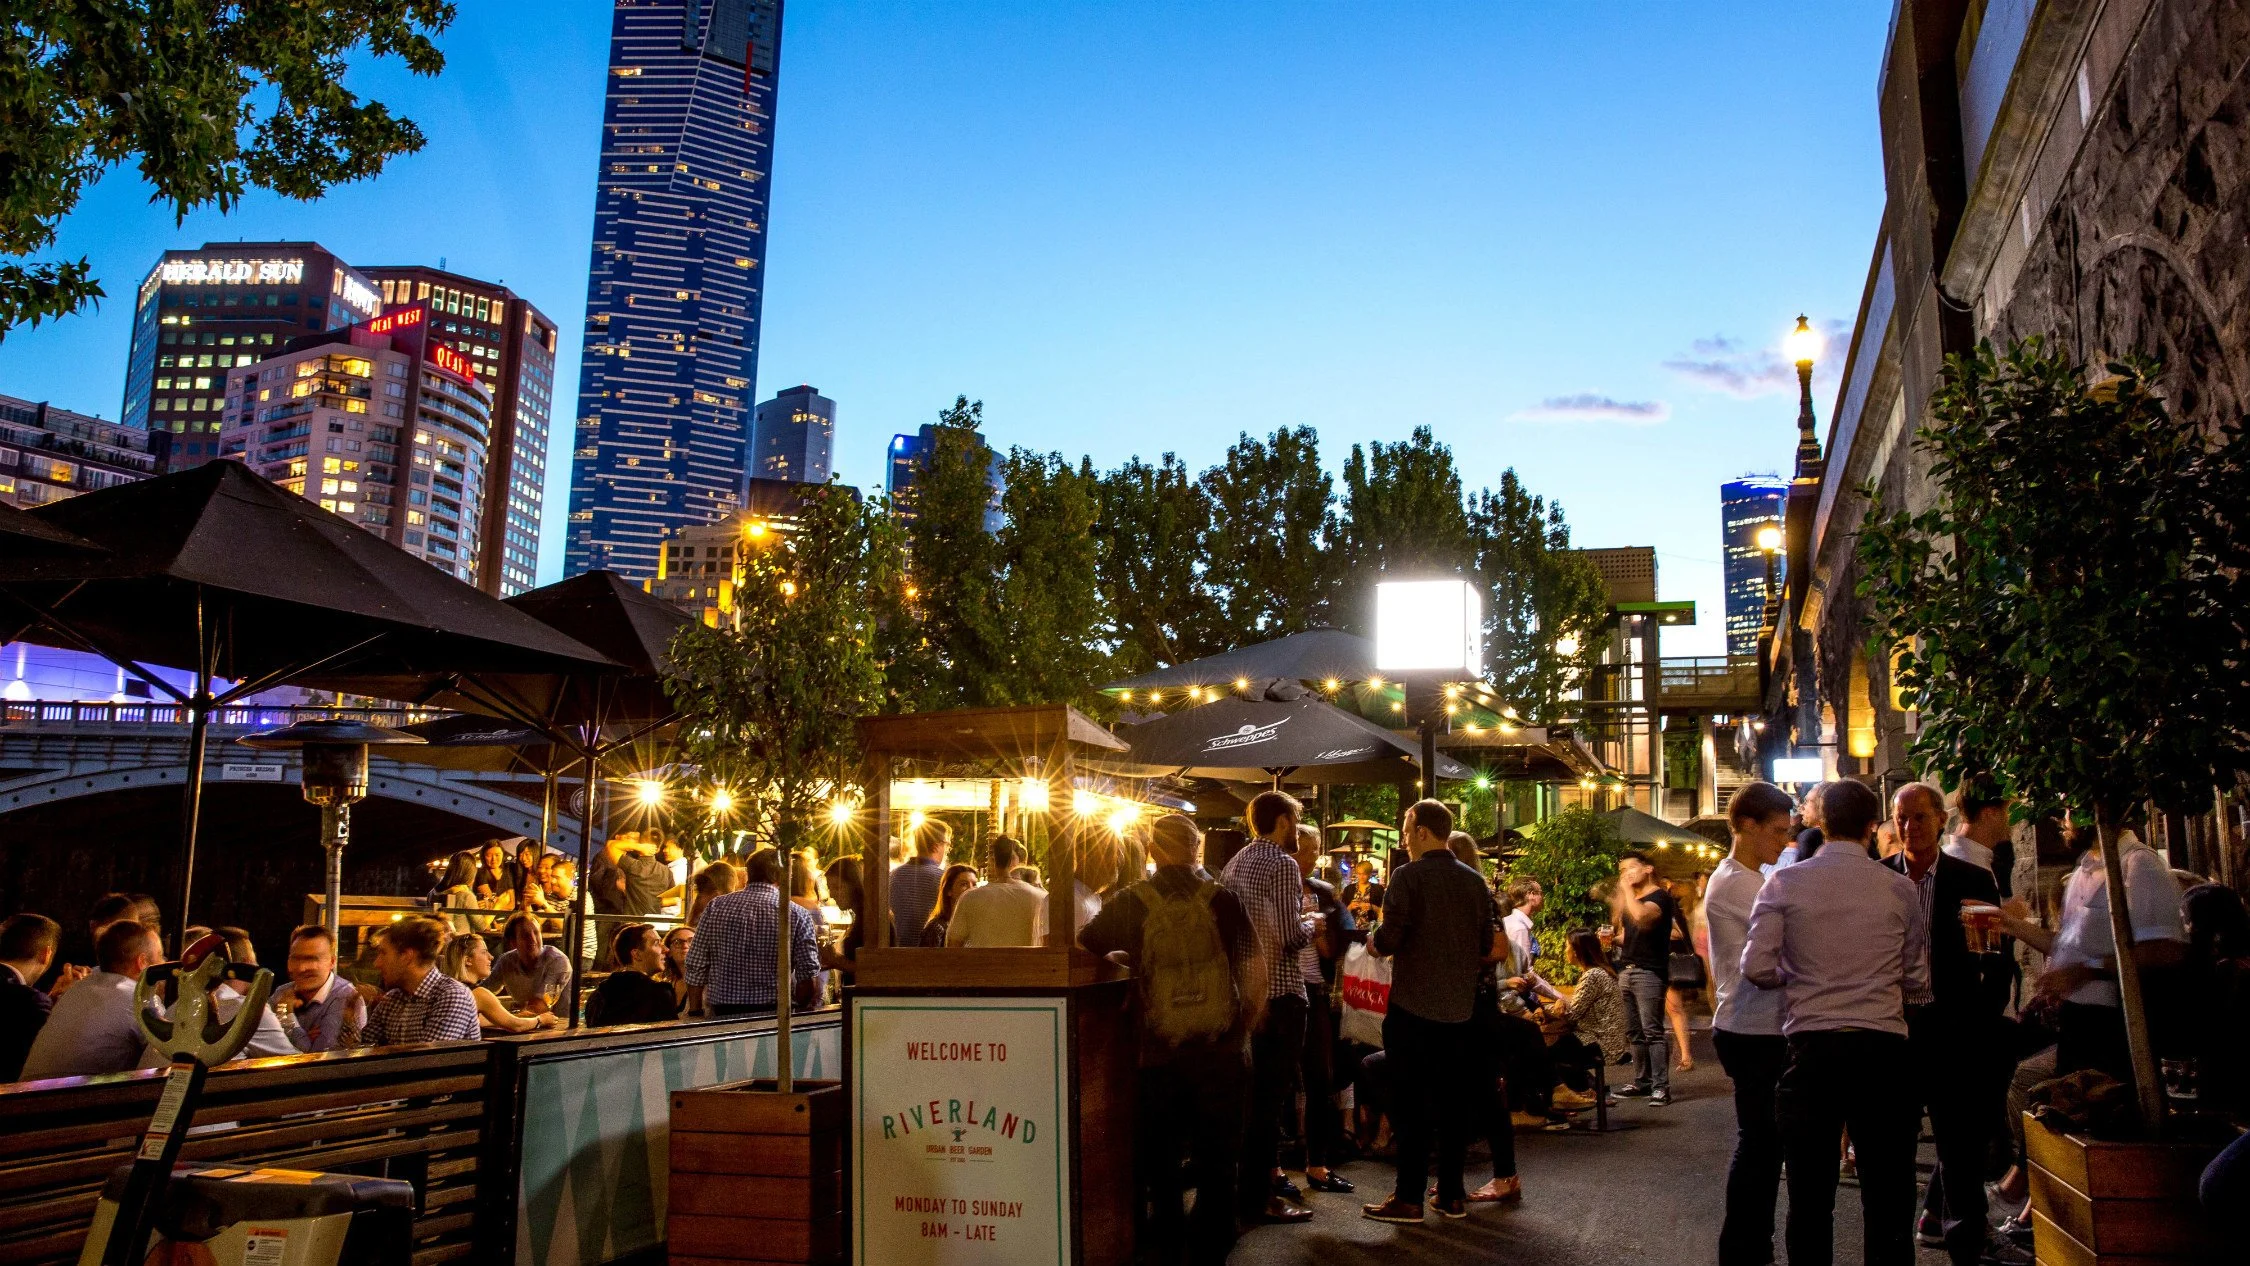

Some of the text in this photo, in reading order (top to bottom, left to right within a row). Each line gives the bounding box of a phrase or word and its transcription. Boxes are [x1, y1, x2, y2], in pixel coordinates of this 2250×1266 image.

[161, 261, 304, 281] HERALD SUN
[397, 309, 421, 325] WEST
[1211, 727, 1278, 748] Schweppes
[907, 1041, 1007, 1062] WELCOME TO
[882, 1098, 1037, 1144] RIVERLAND
[925, 1144, 993, 1156] URBAN BEER GARDEN
[895, 1196, 1023, 1218] MONDAY TO SUNDAY
[921, 1222, 948, 1238] 8AM
[966, 1224, 996, 1241] LATE
